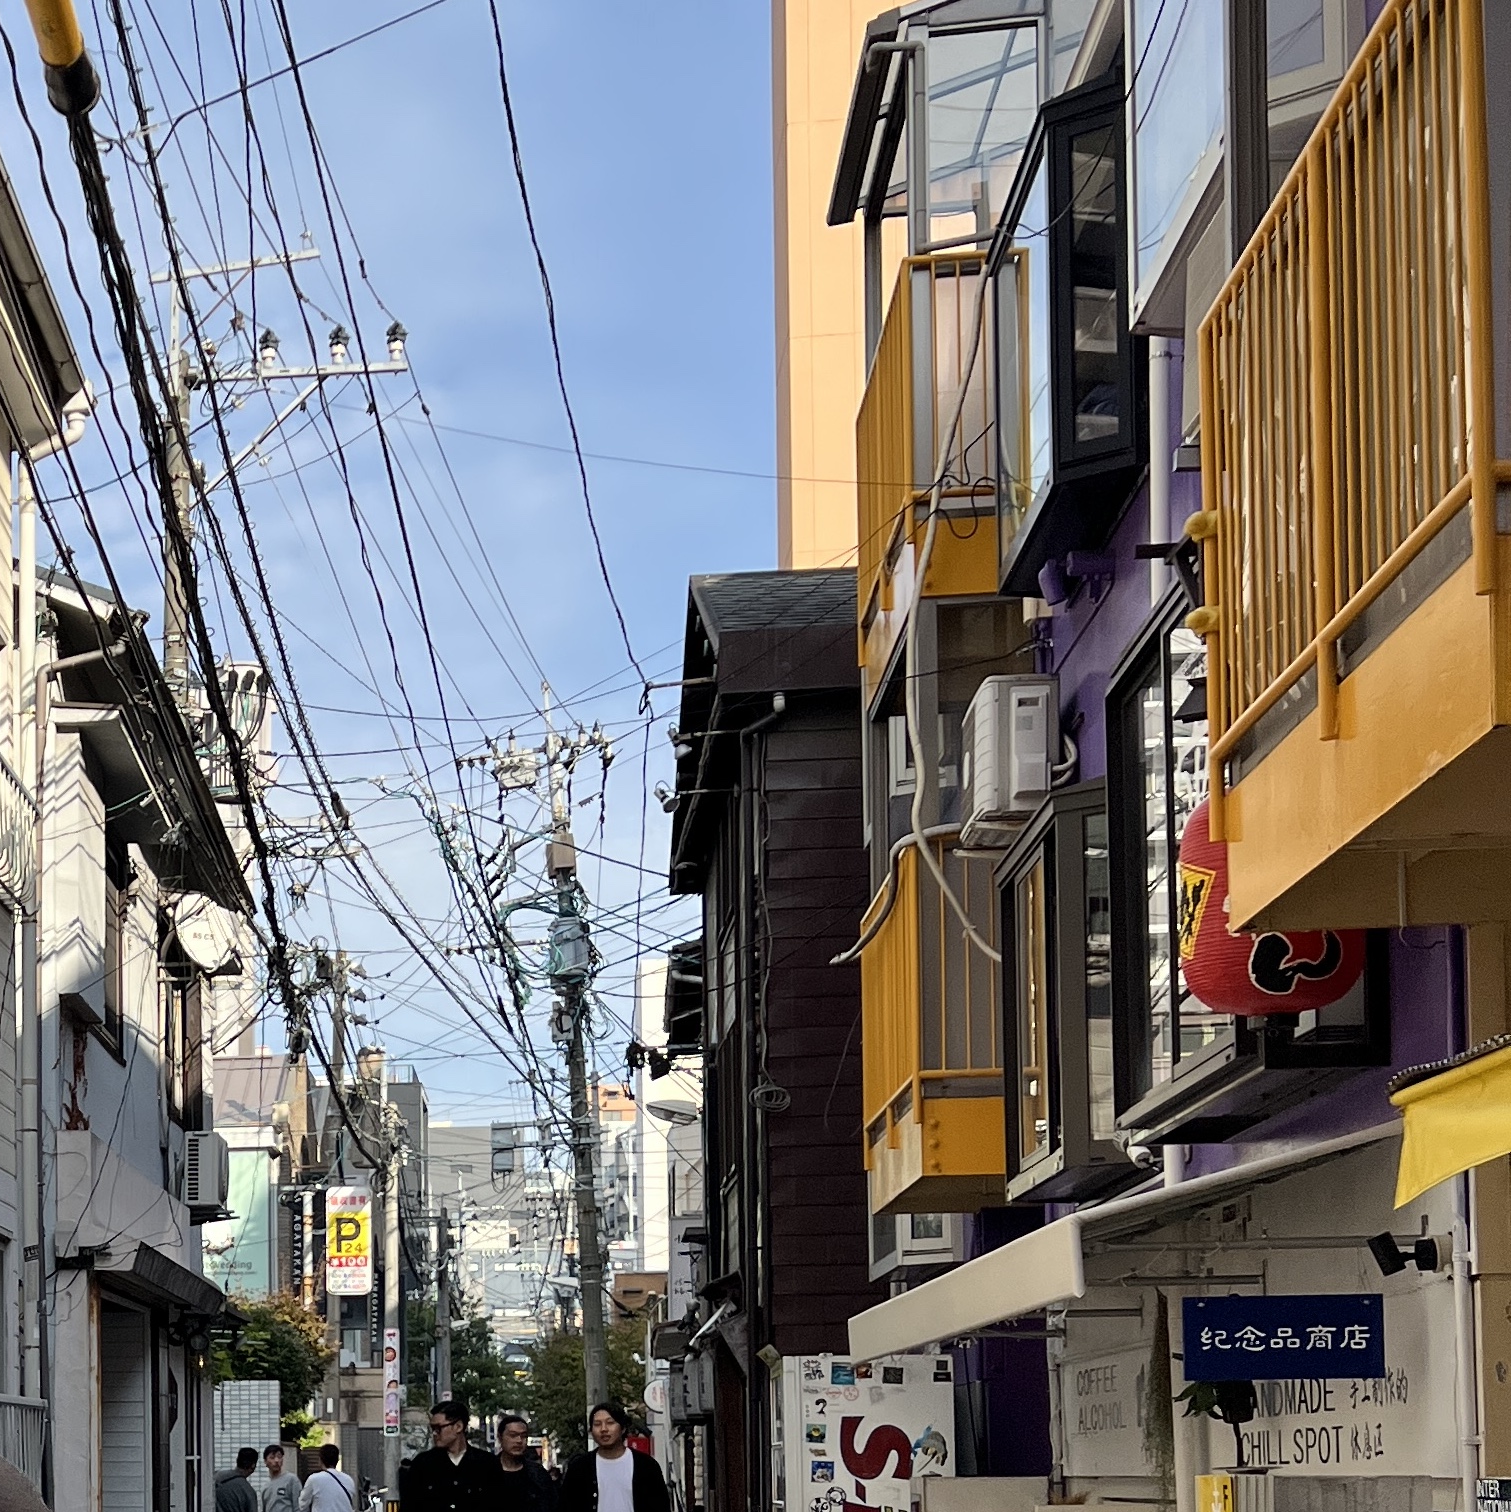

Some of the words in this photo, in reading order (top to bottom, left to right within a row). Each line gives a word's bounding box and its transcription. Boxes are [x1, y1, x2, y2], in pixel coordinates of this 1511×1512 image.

[335, 1217, 361, 1253] P
[345, 1243, 363, 1254] 24
[1200, 1324, 1371, 1351] 纪念品商店
[1076, 1364, 1118, 1396] COFFEE
[1078, 1400, 1127, 1432] ALCOHOL
[1242, 1429, 1290, 1466] CHILL
[1293, 1426, 1343, 1465] SPOT
